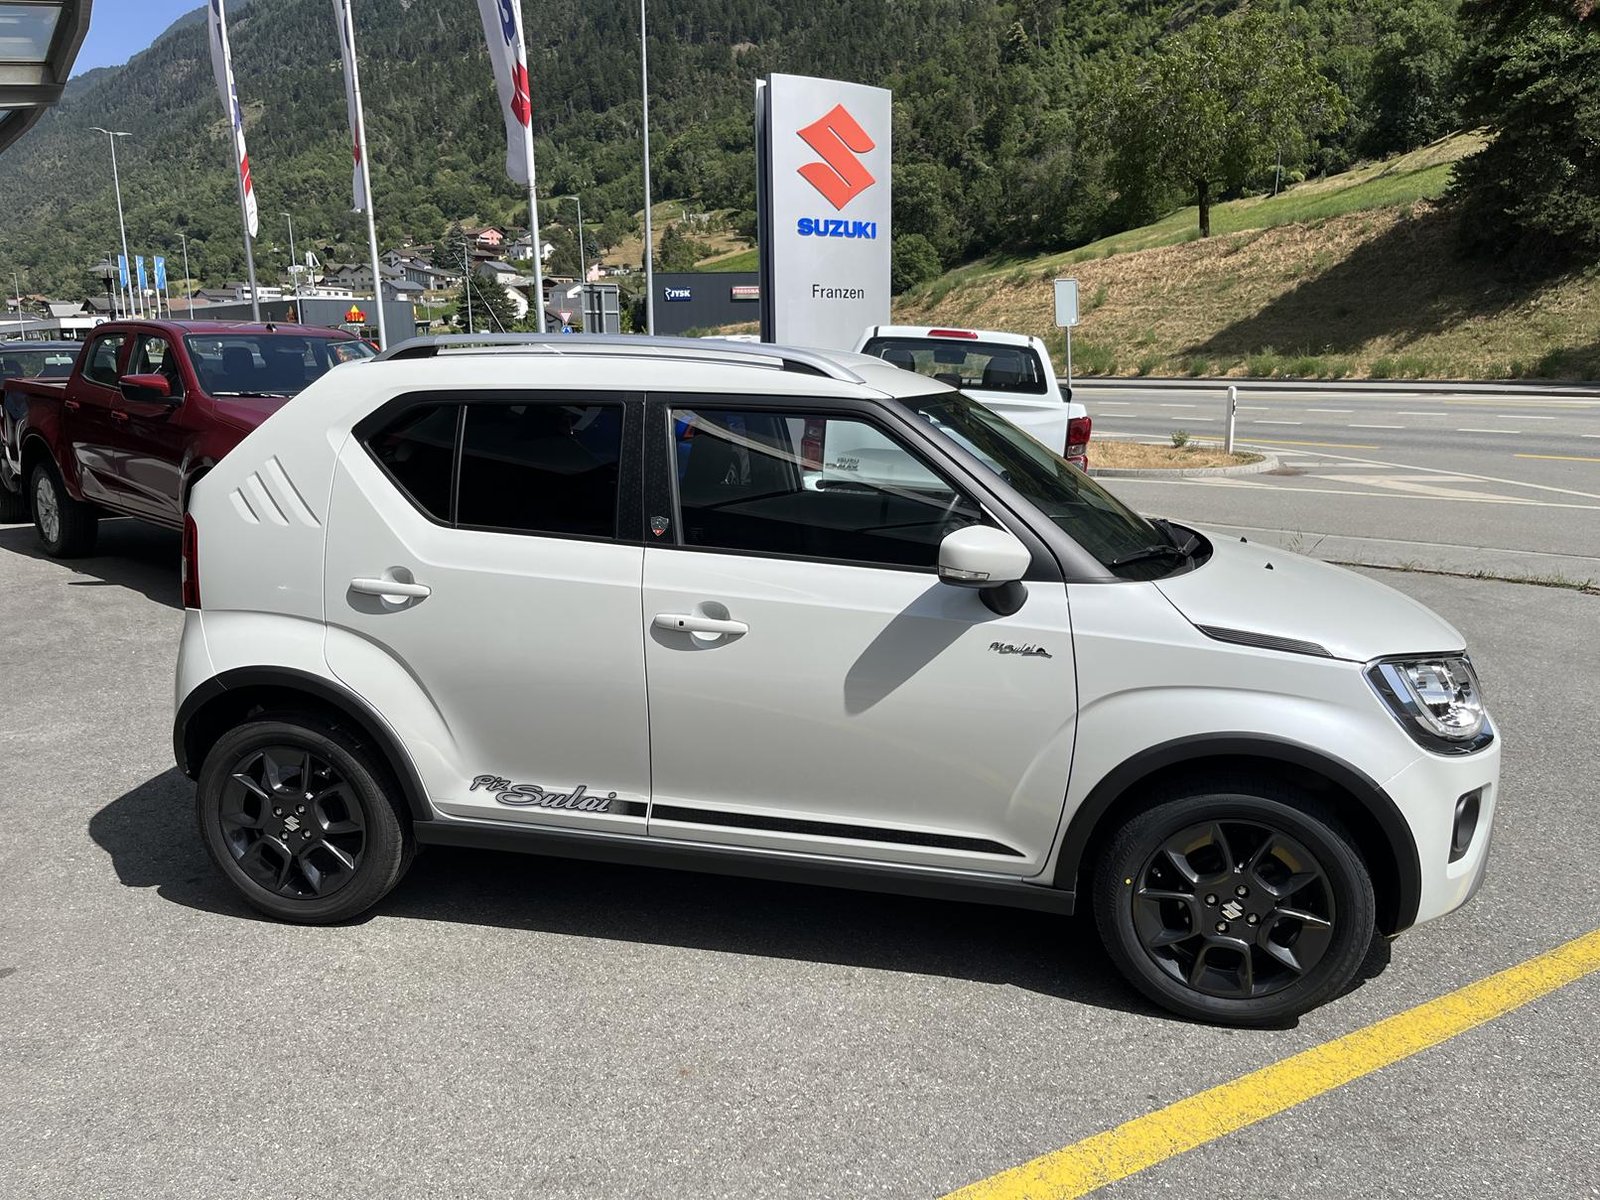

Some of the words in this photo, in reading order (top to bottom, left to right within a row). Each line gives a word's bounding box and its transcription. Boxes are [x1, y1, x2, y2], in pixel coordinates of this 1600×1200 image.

[797, 218, 877, 239] SUZUKI
[670, 290, 691, 298] JYSK
[812, 284, 865, 299] Franzen
[470, 774, 511, 791] Piz
[495, 784, 617, 812] Sulai
